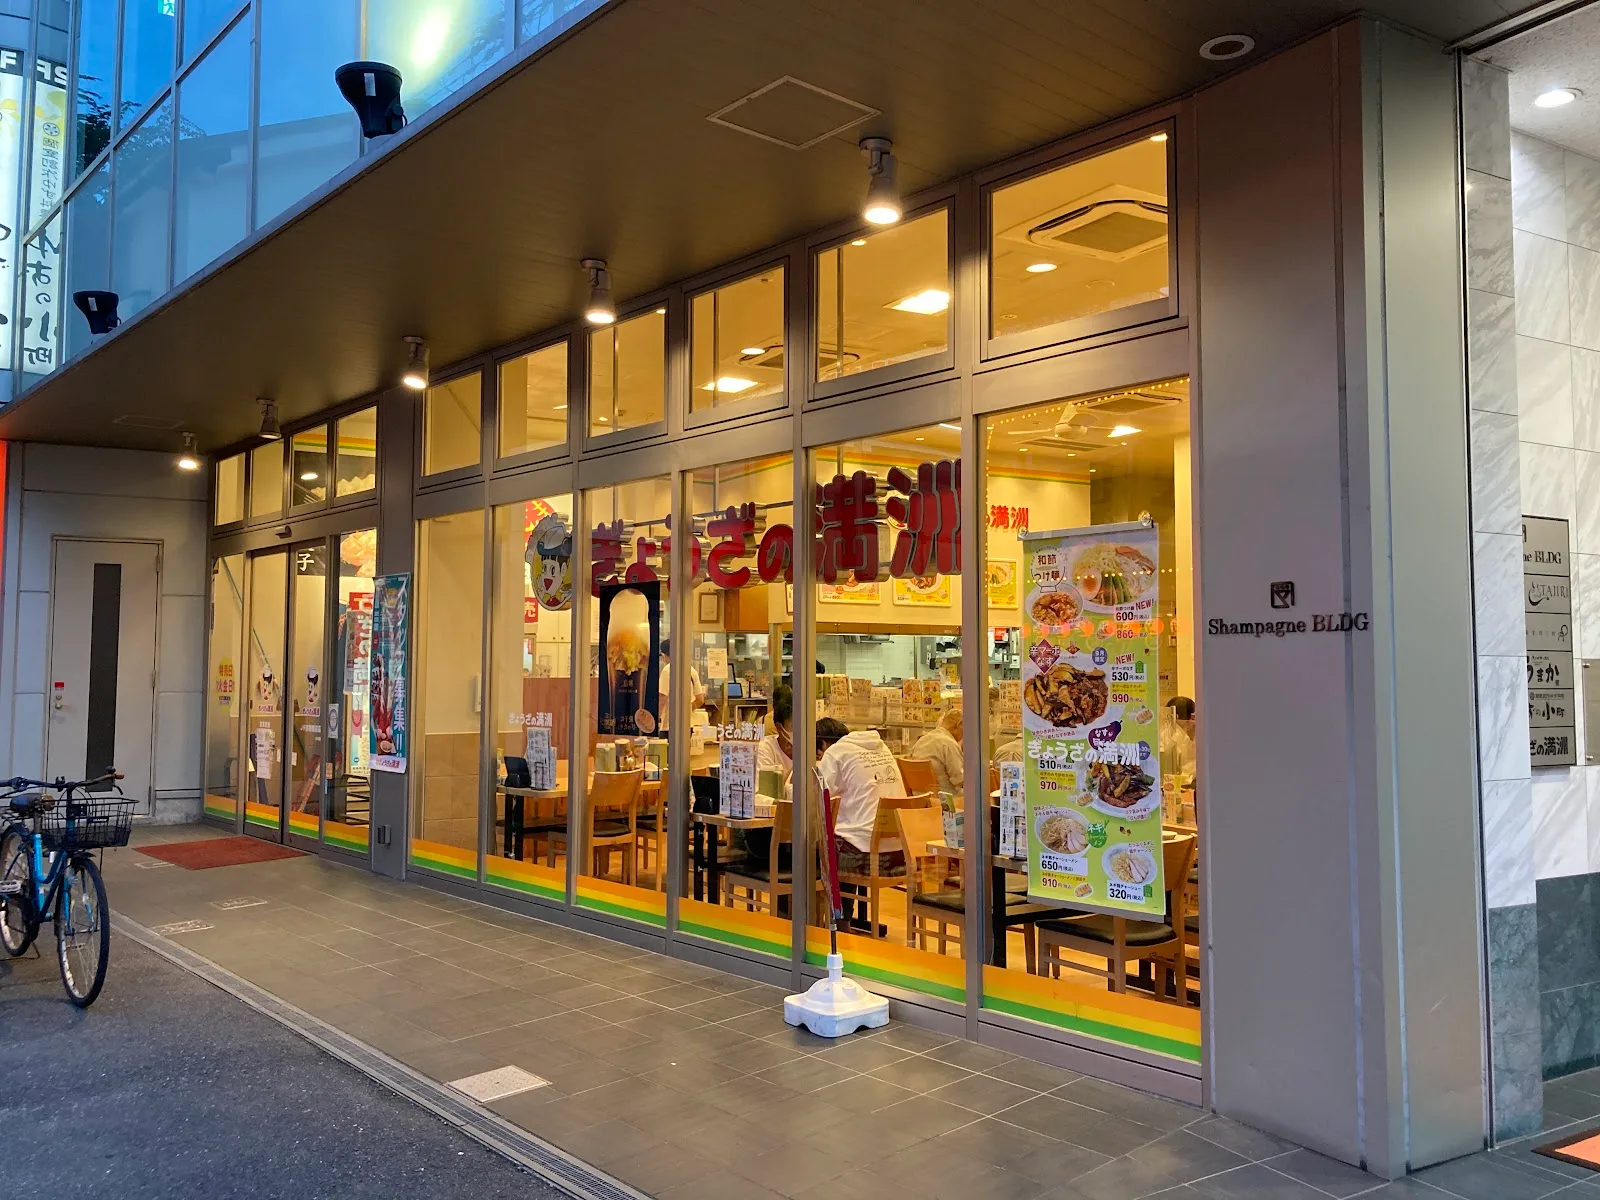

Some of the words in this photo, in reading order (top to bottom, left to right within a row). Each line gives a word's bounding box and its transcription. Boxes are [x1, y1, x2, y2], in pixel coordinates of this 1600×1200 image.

[297, 553, 315, 571] 子
[1037, 554, 1057, 566] 和節
[1534, 550, 1562, 564] BLDG
[1034, 570, 1060, 582] つけ麺
[1135, 598, 1155, 612] NEW!
[1208, 618, 1306, 638] Shampagne
[1311, 612, 1369, 632] BLDG
[1036, 656, 1054, 668] なす
[1115, 653, 1135, 665] NEW!
[1027, 741, 1140, 765] ぎょうざの満洲
